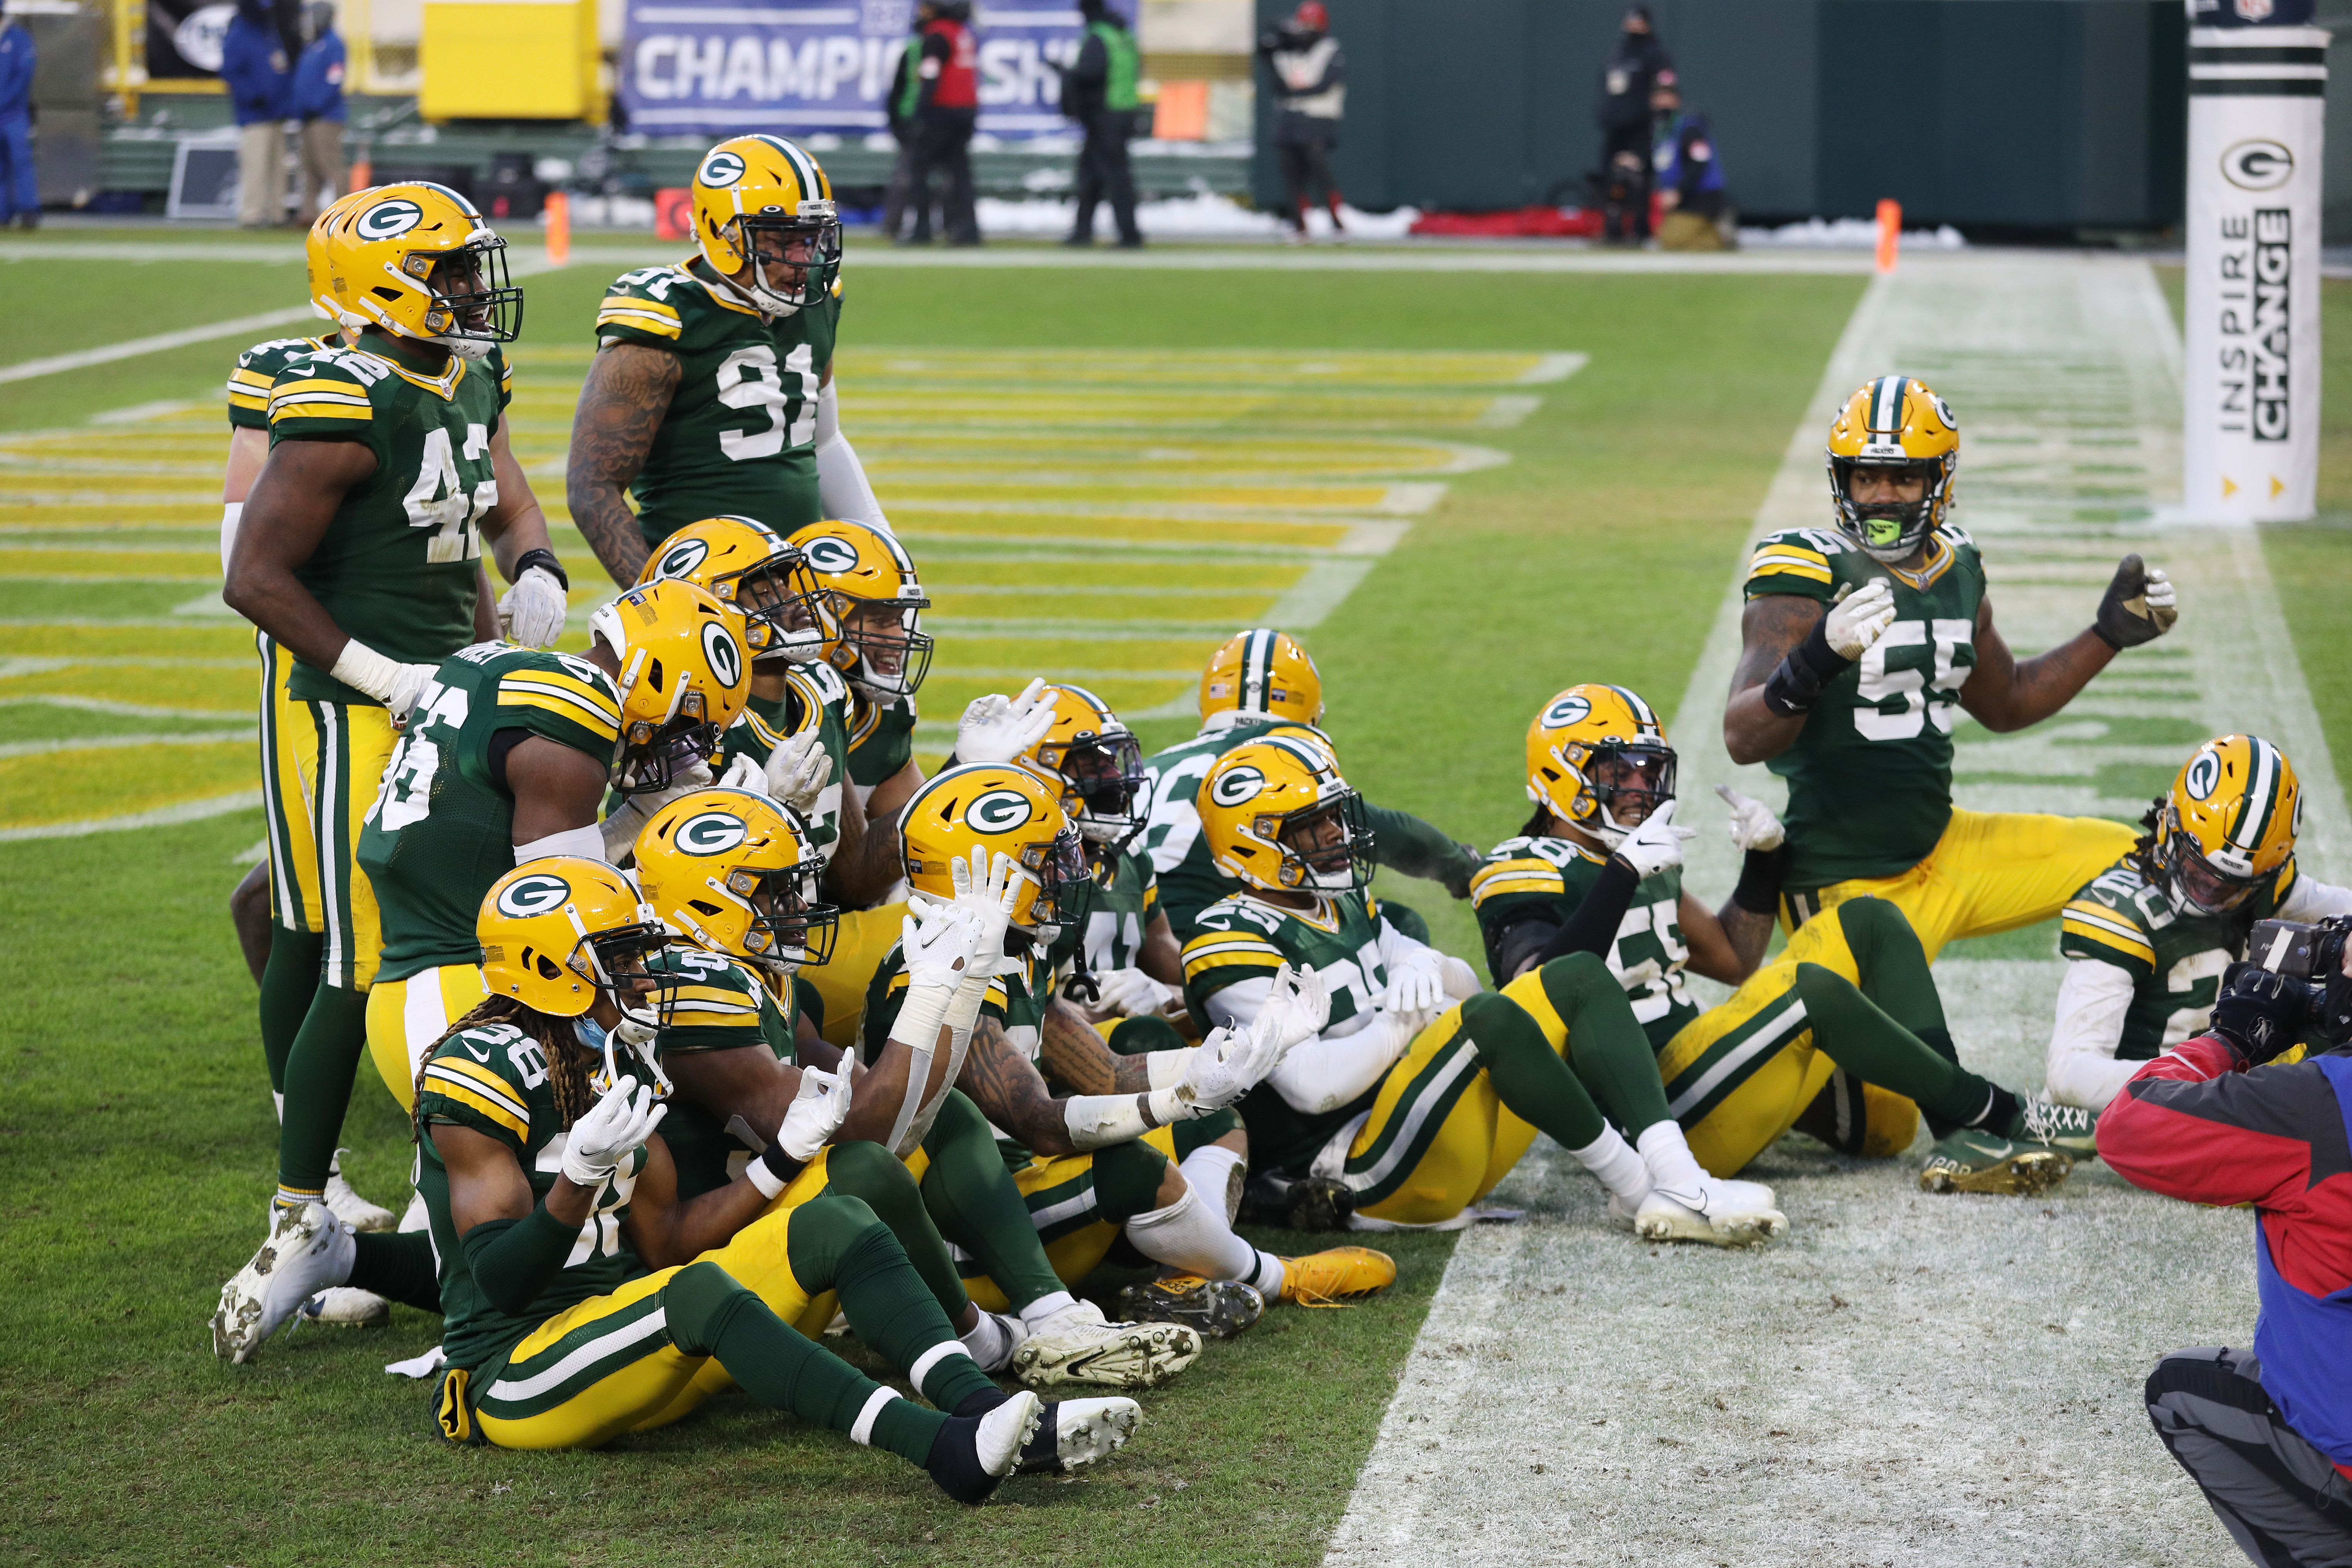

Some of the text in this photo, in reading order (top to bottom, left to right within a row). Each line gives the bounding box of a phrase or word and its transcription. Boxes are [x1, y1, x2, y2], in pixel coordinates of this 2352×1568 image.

[716, 343, 819, 461] 91
[2219, 215, 2248, 433] INSPIRE
[2253, 209, 2291, 440] CHANGE
[1854, 619, 1977, 742] 55
